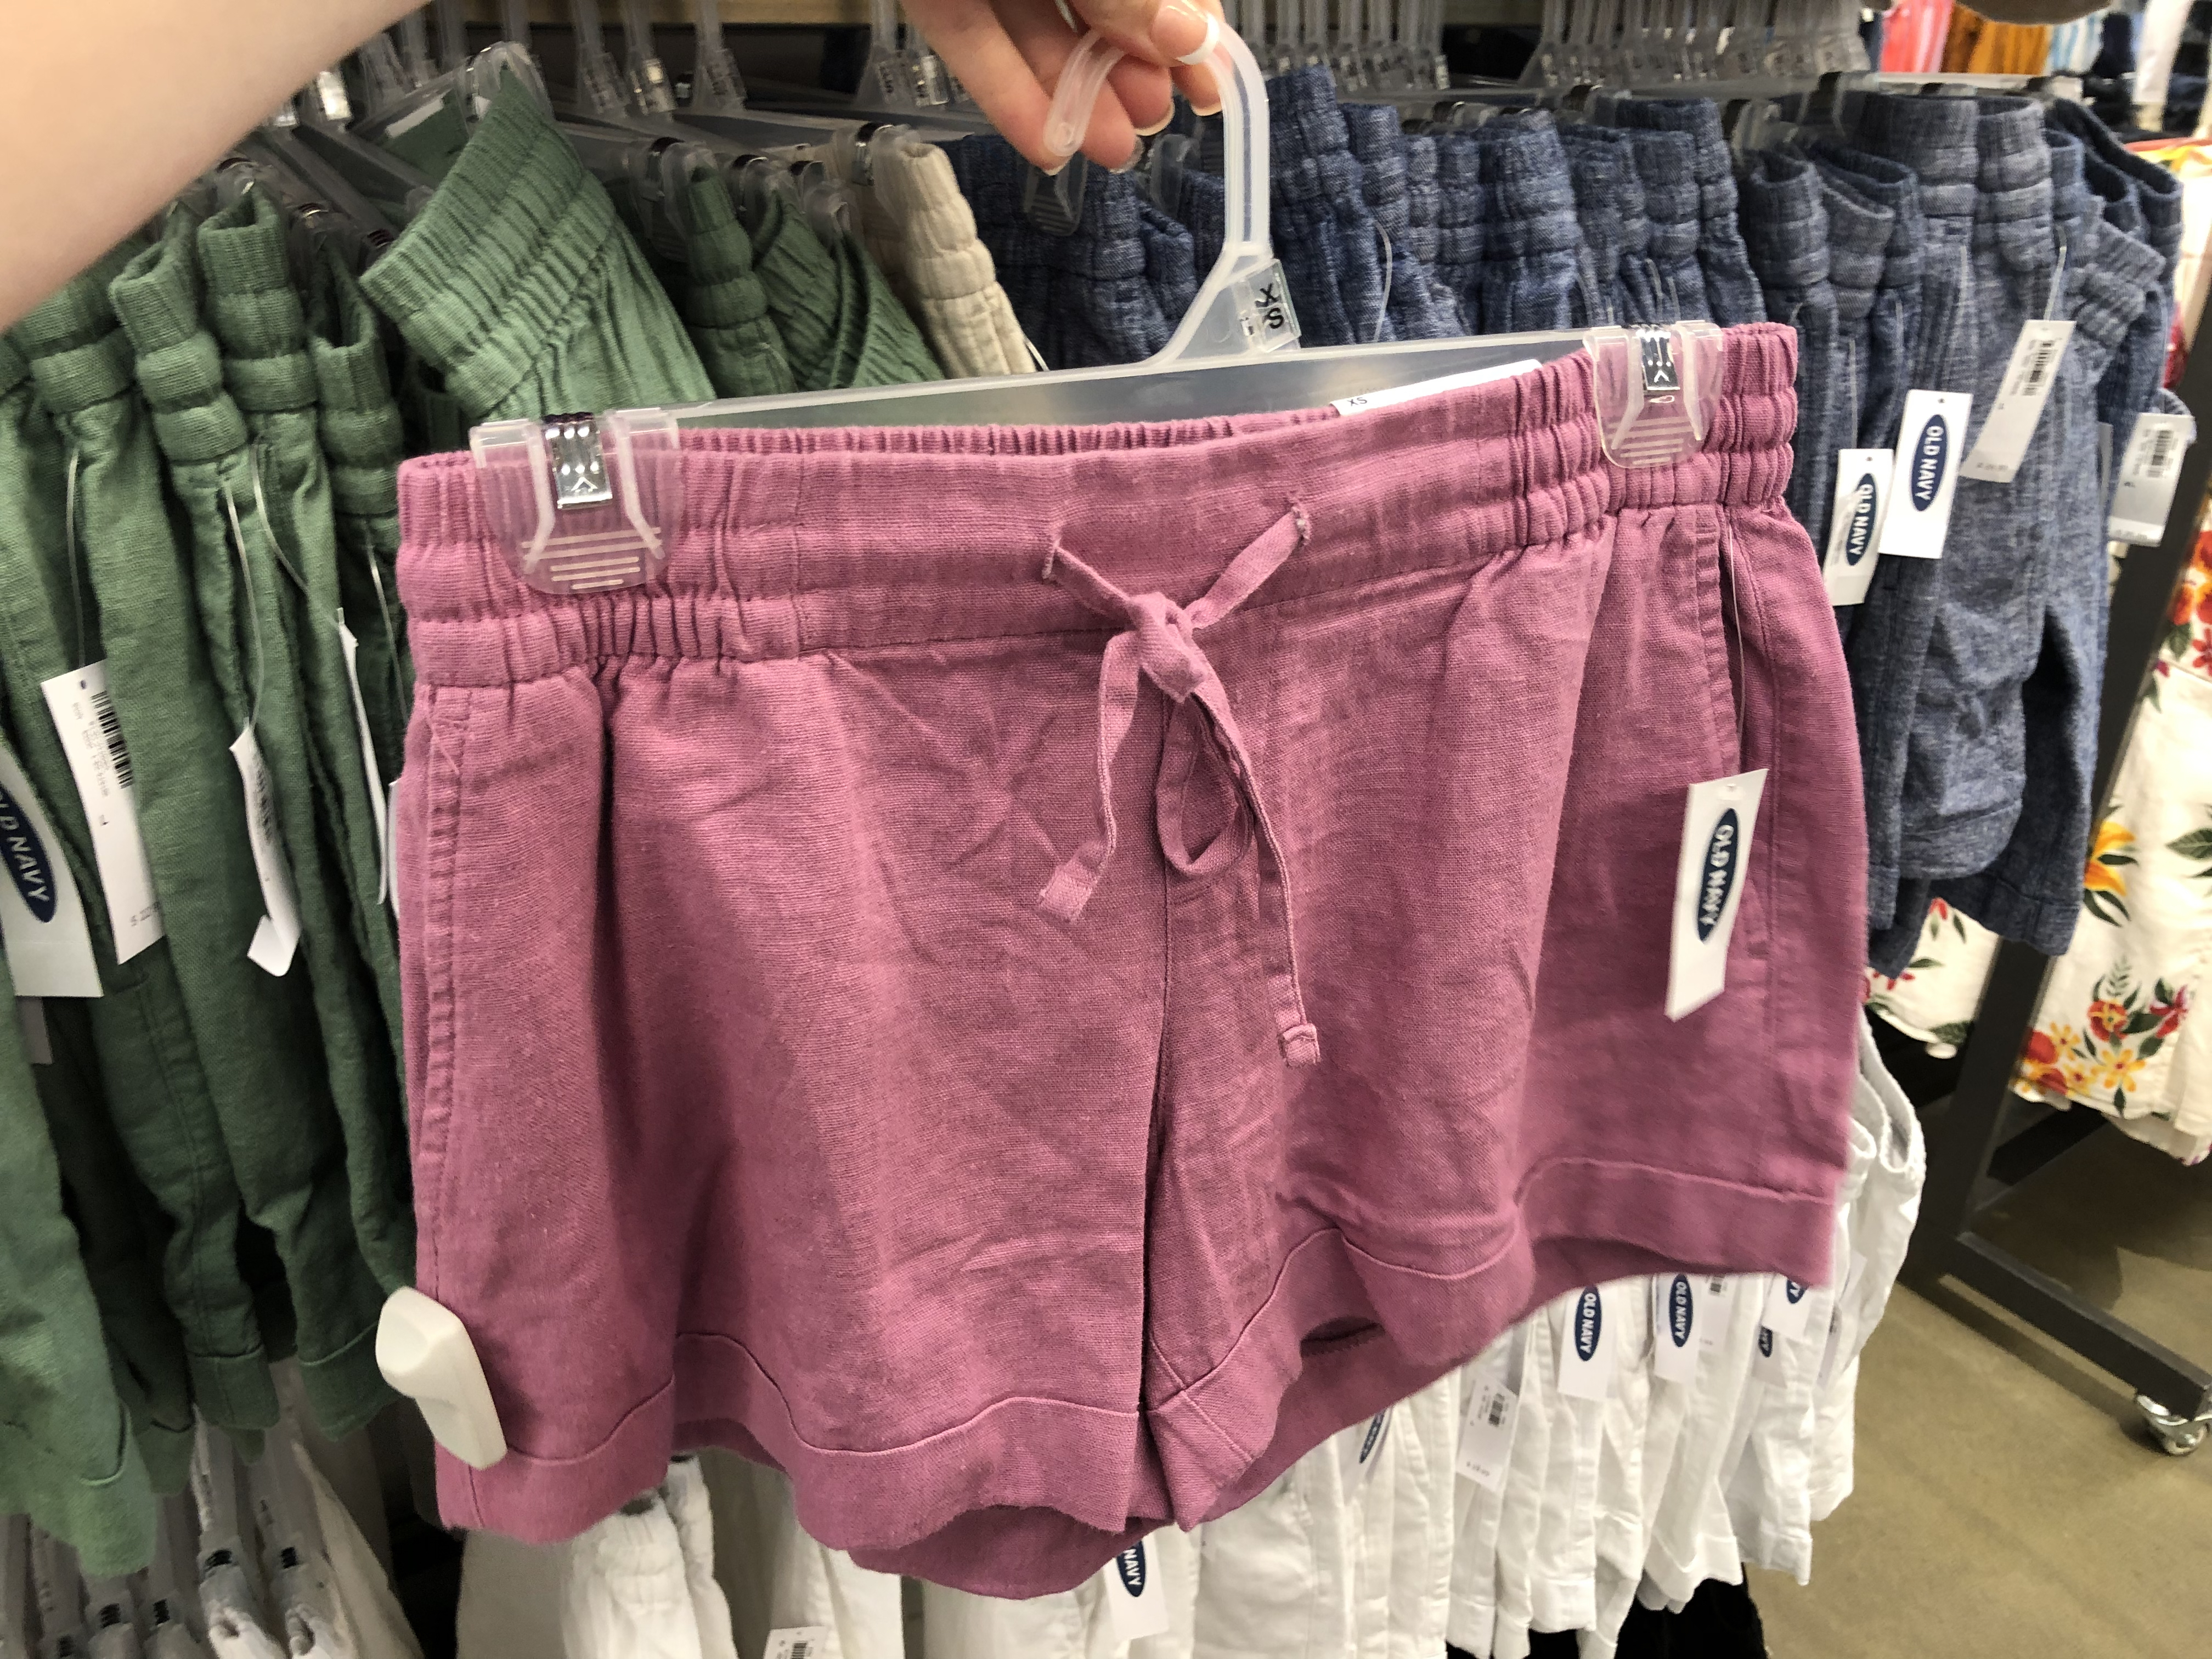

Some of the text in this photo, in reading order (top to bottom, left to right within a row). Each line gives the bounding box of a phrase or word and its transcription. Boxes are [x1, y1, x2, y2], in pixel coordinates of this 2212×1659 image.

[1256, 283, 1284, 329] XS
[1347, 397, 1368, 407] XS
[1915, 425, 1944, 501] OLD NAVY
[1849, 483, 1874, 555] OLD NAVY
[8, 836, 50, 902] NAVY
[1699, 824, 1734, 926] OLD NAVY
[1579, 1293, 1597, 1354] OLD NAVY
[1674, 1281, 1687, 1340] OLD NAVY
[1122, 1548, 1142, 1585] NAVY
